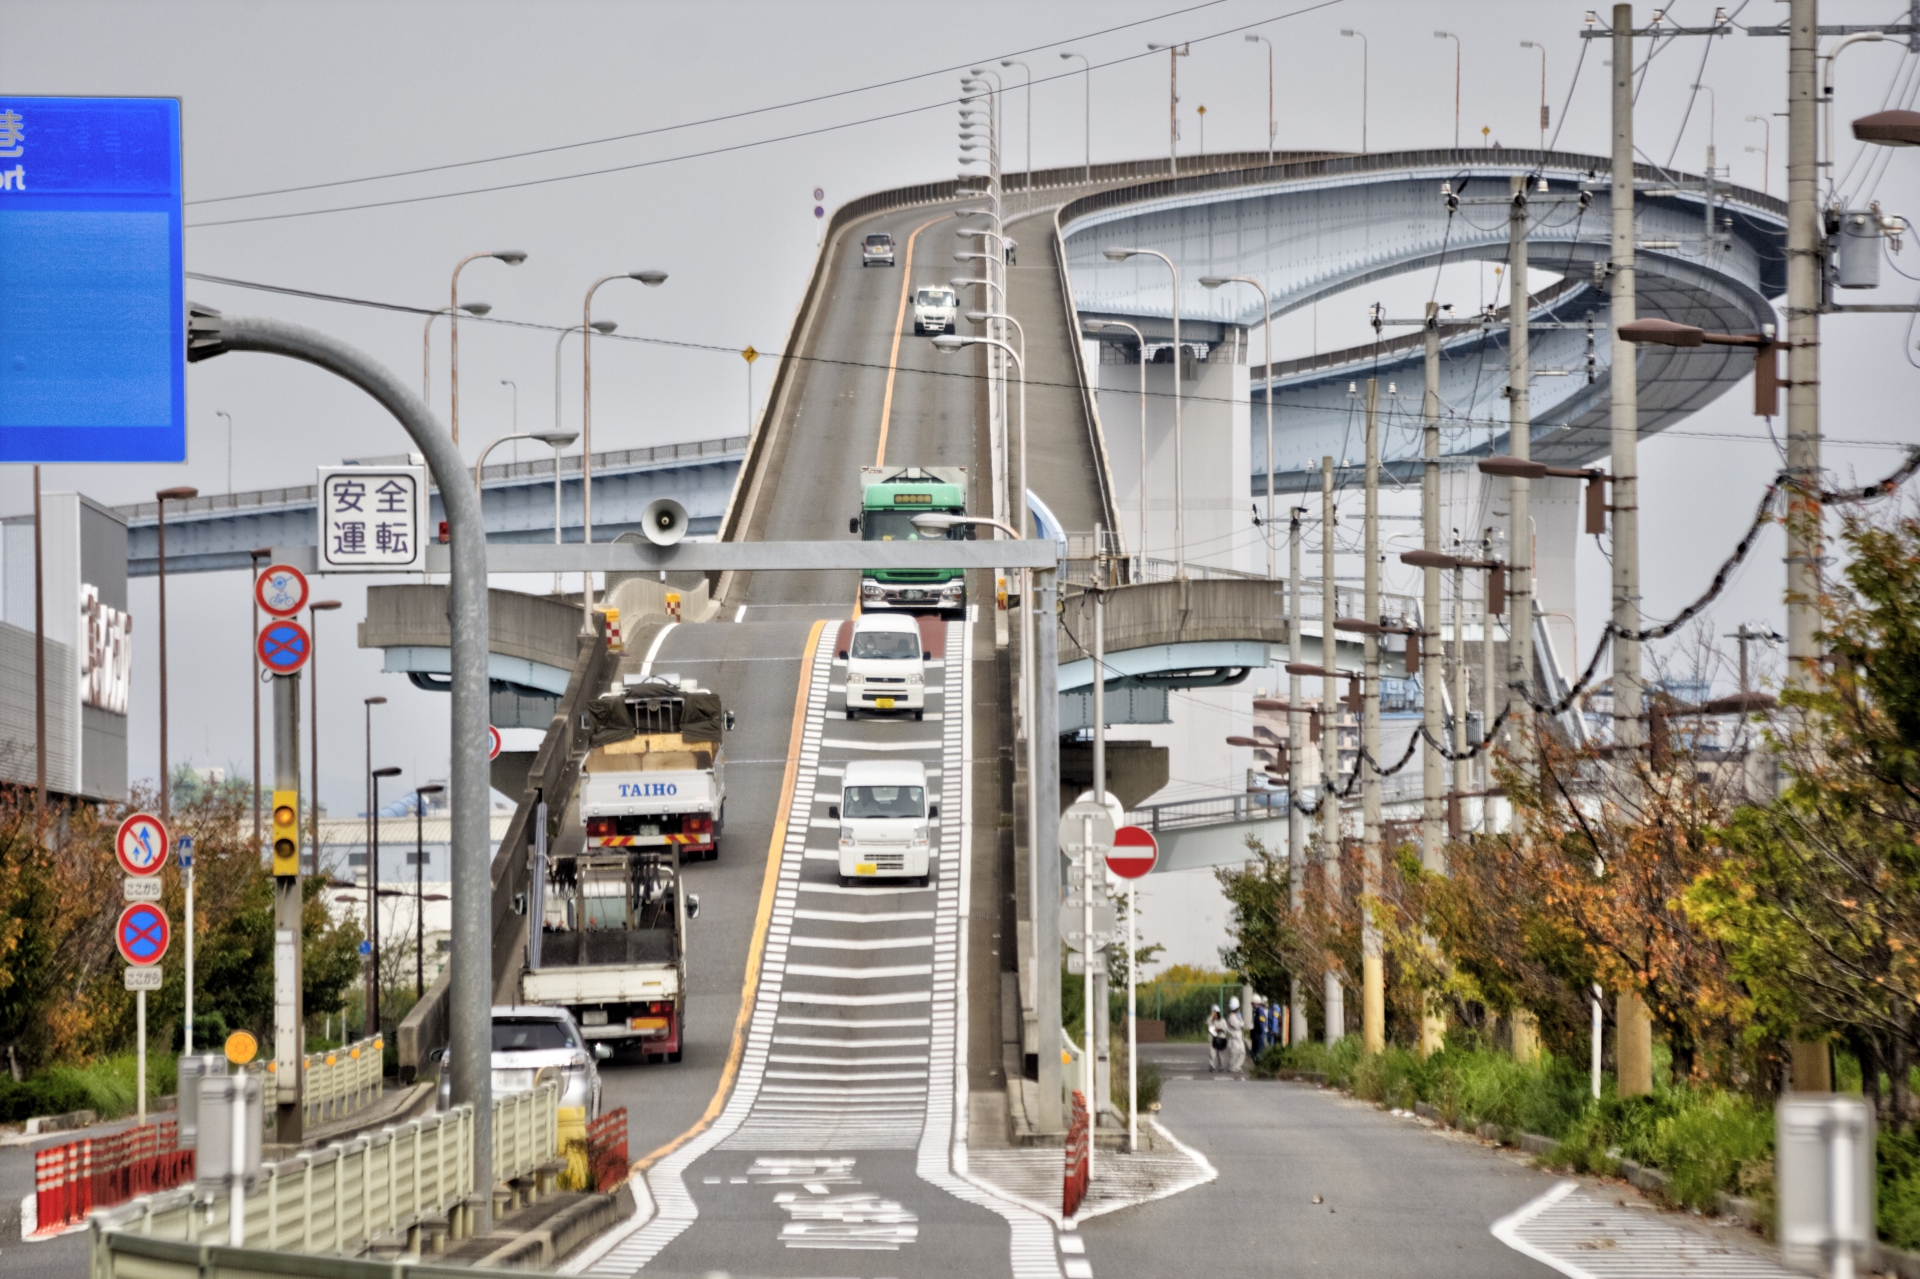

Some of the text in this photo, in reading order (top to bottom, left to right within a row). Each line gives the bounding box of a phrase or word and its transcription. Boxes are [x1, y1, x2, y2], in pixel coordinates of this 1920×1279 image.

[333, 480, 408, 513] 安全
[333, 521, 409, 555] 運転
[126, 883, 160, 896] ここから
[126, 971, 161, 986] ここから
